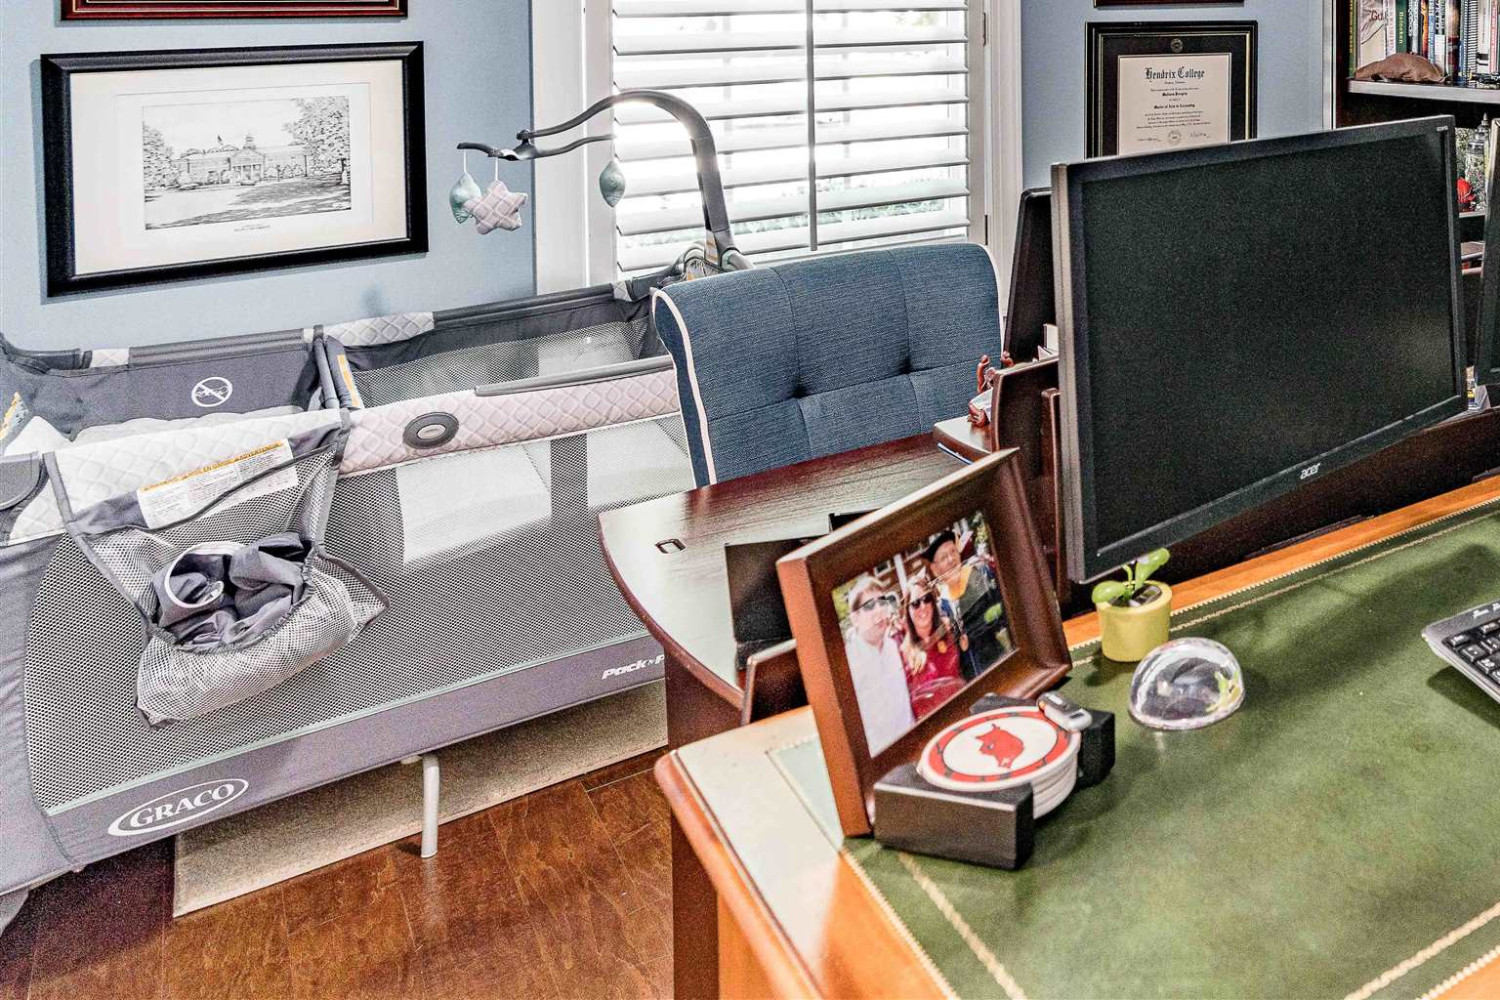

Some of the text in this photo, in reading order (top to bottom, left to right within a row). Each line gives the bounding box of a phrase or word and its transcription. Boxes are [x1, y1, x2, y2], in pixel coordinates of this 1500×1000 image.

[1145, 66, 1204, 80] Hendrix College
[1300, 462, 1320, 480] acer
[602, 660, 646, 680] Pack
[130, 784, 234, 828] GRACO
